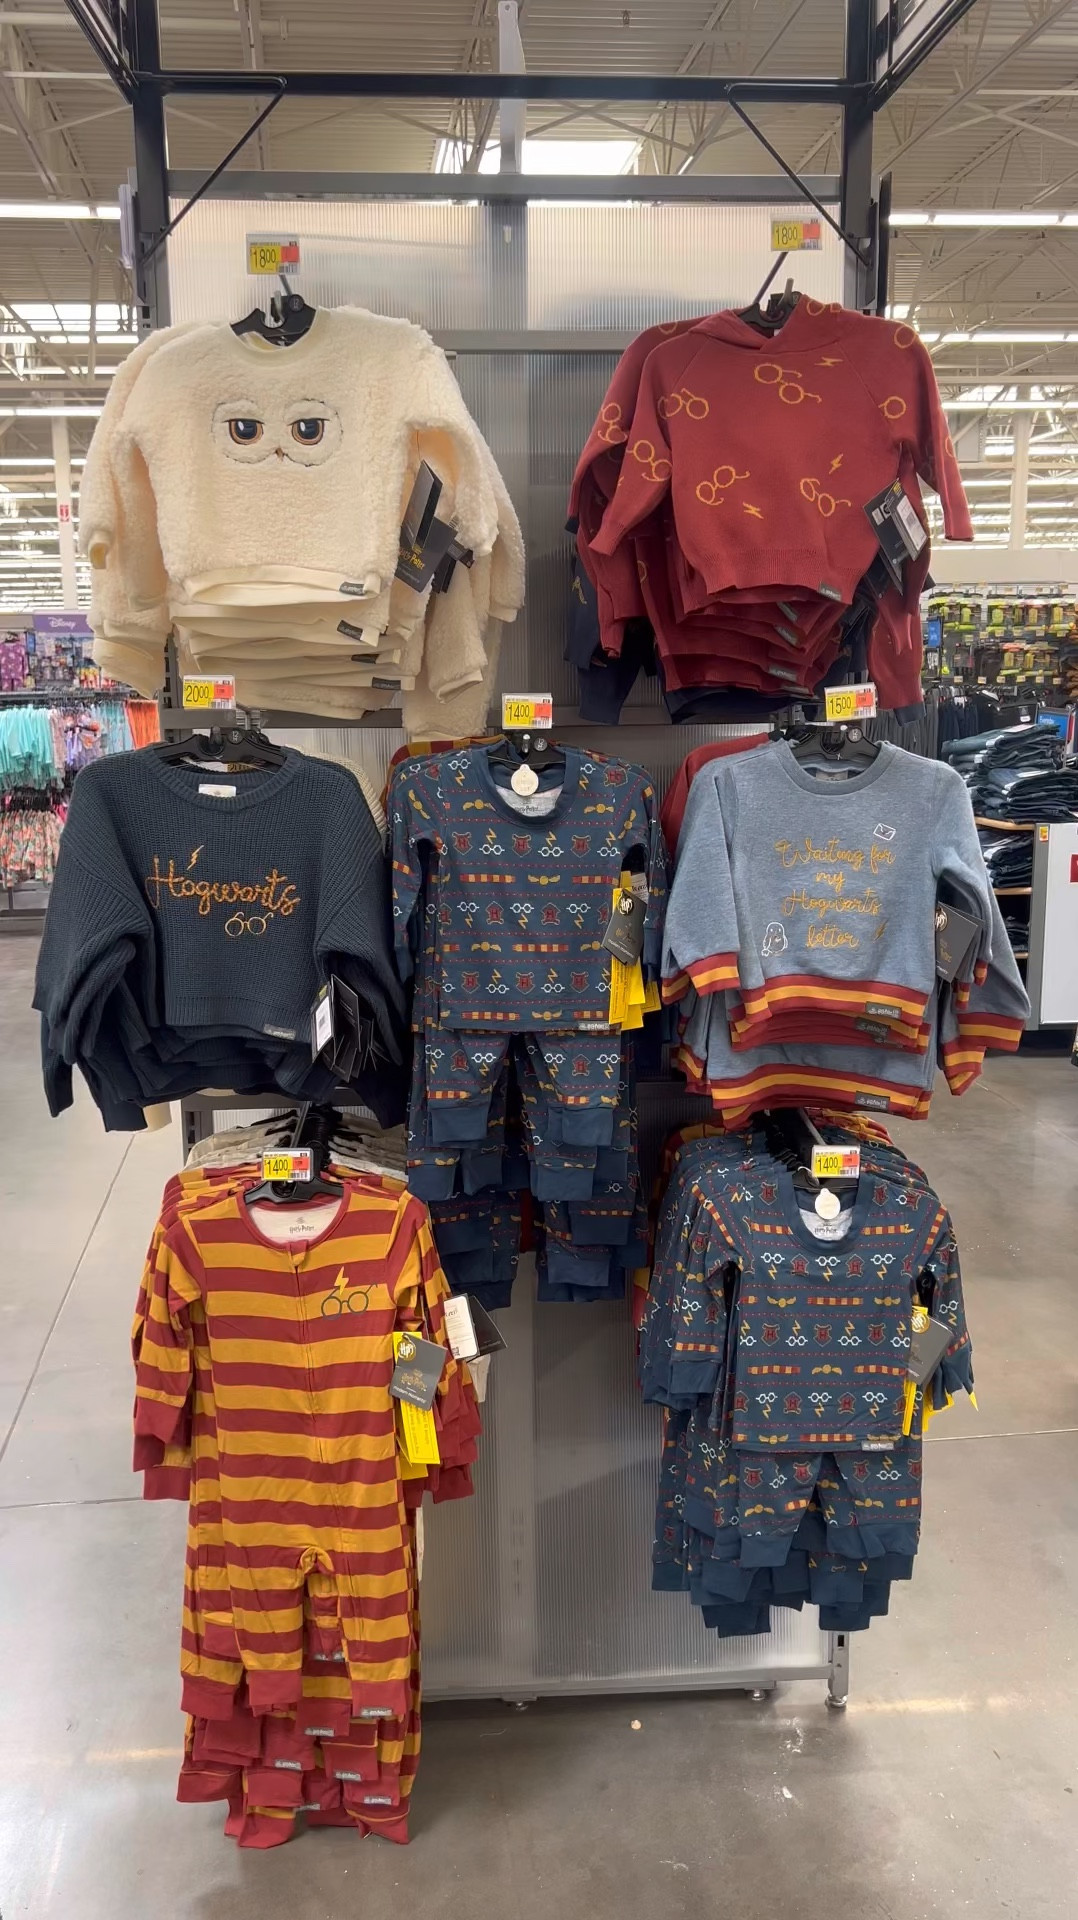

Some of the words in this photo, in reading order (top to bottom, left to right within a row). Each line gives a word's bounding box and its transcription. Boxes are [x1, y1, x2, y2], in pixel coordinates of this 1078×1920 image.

[48, 616, 77, 630] Disney
[775, 836, 864, 872] Waiting
[870, 844, 896, 874] for
[145, 854, 301, 916] Hogwarts
[815, 871, 846, 893] my
[783, 888, 882, 919] Hogwarts
[806, 923, 859, 949] letter
